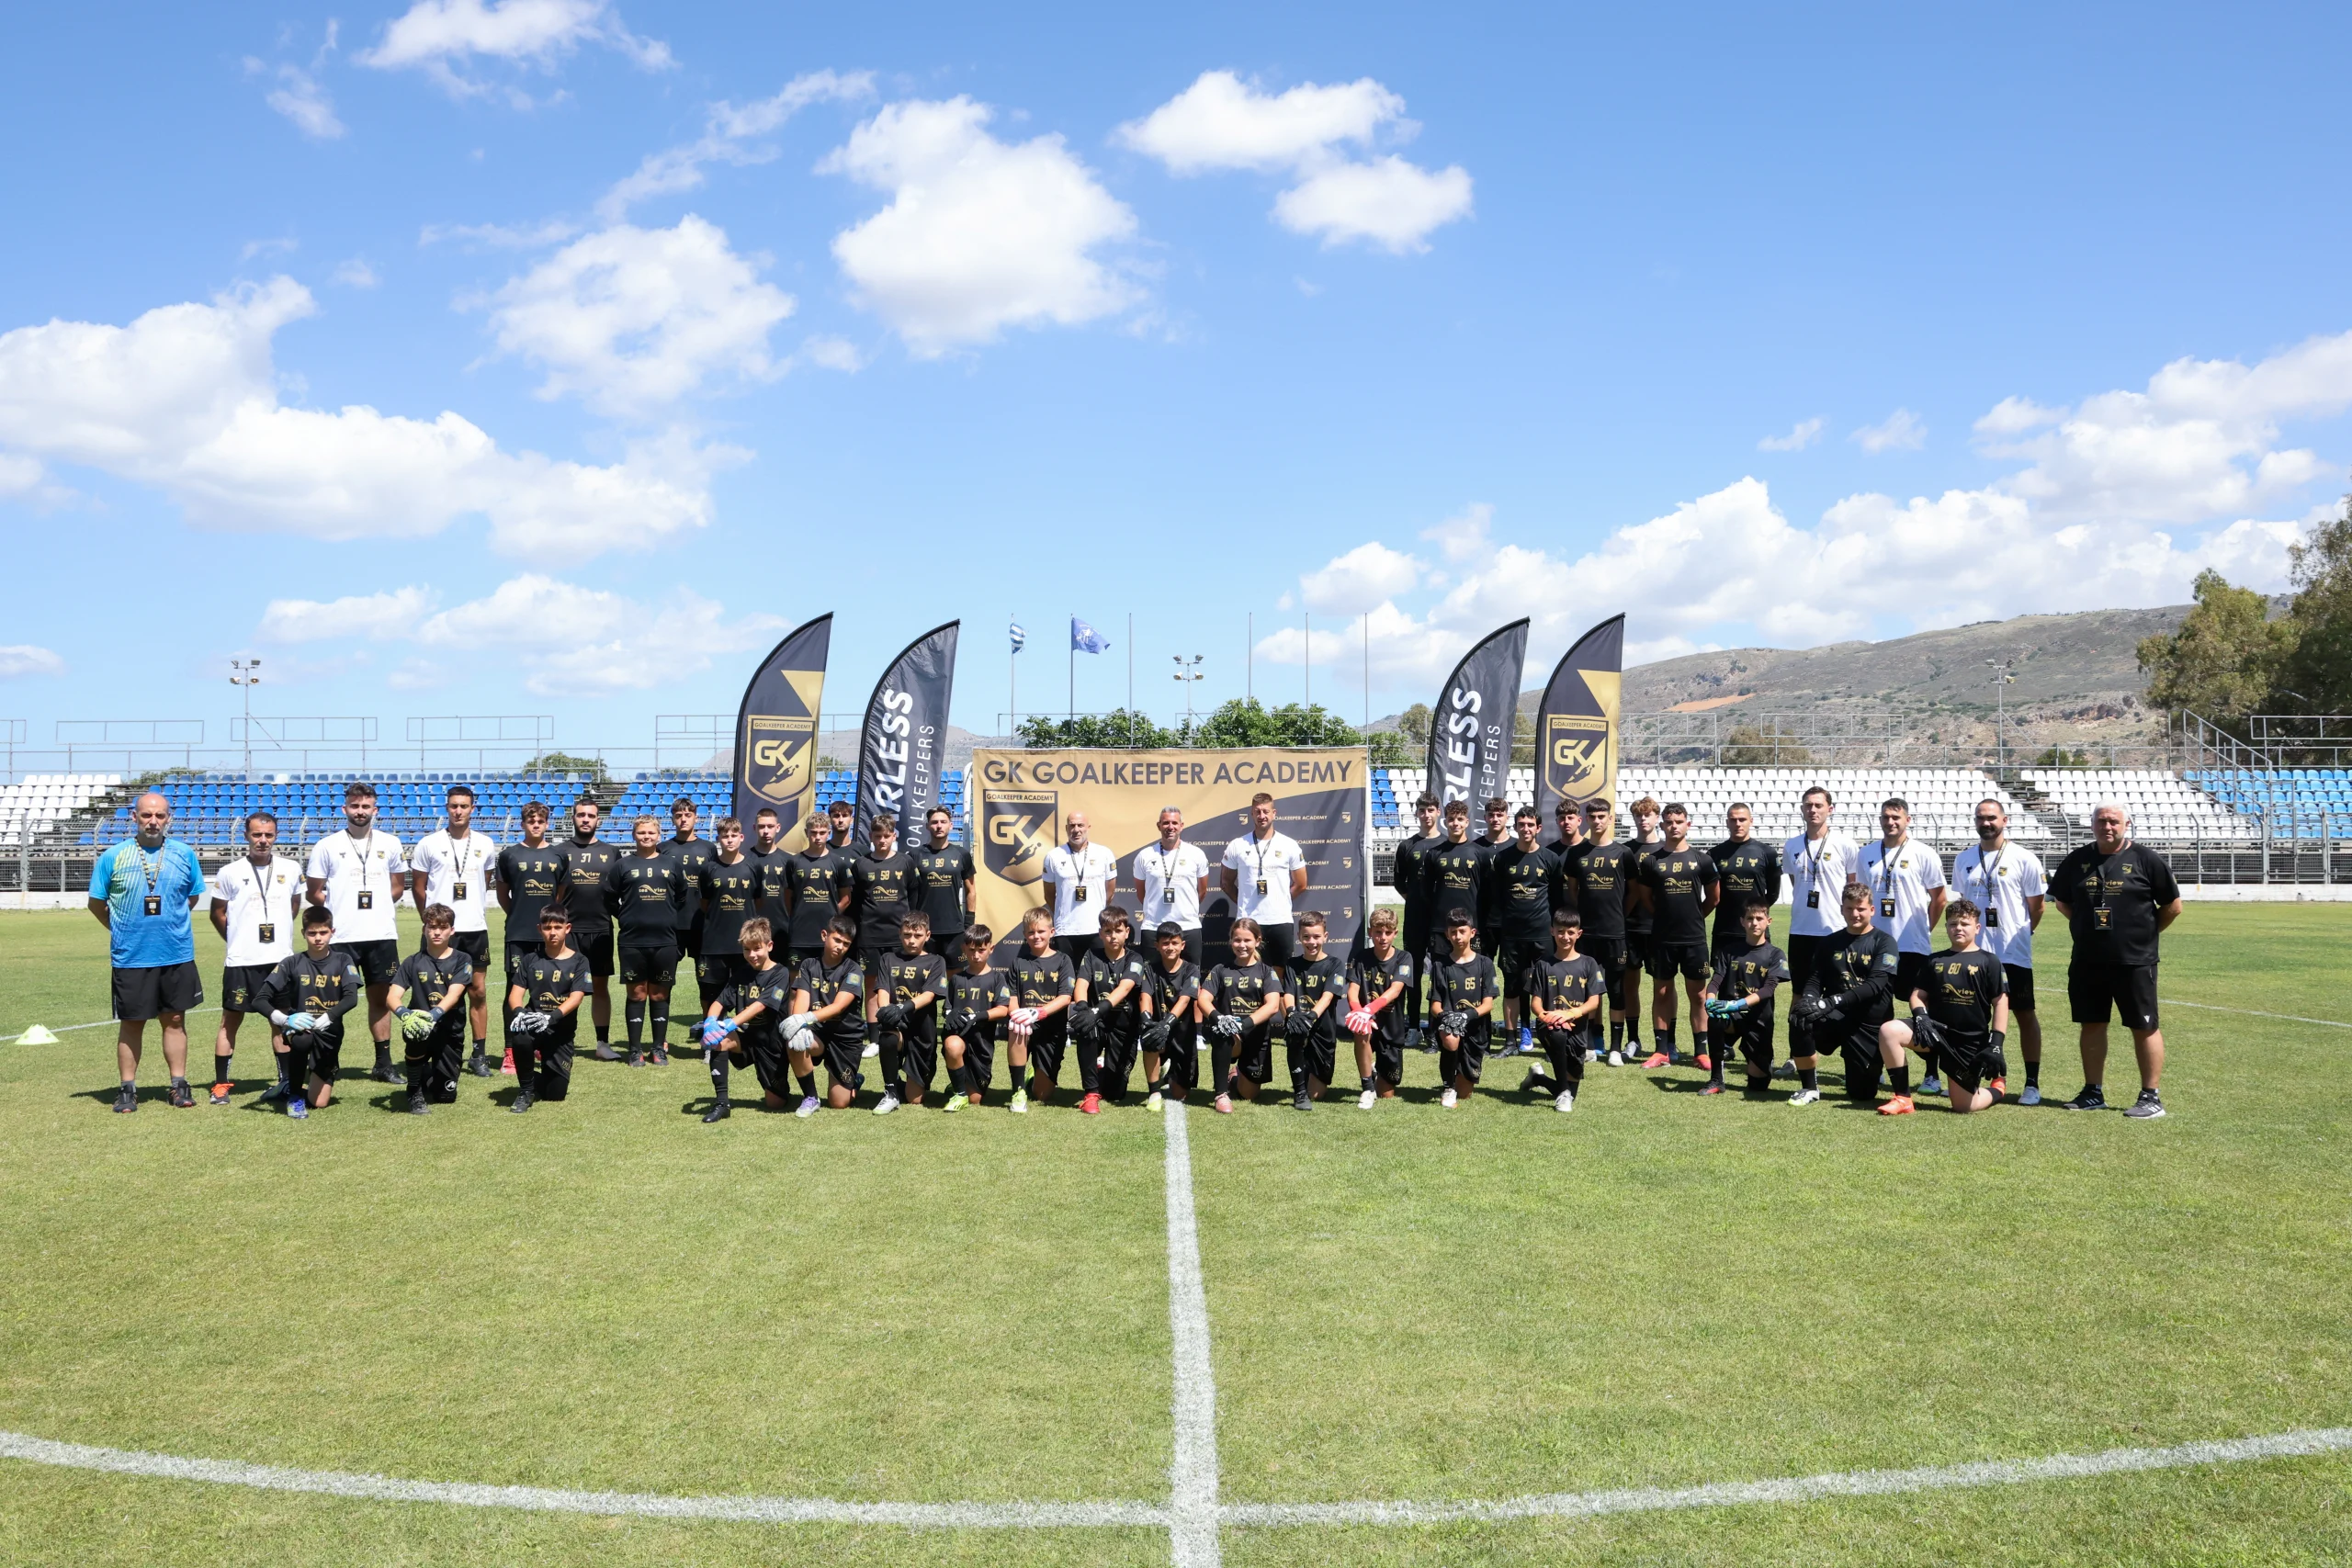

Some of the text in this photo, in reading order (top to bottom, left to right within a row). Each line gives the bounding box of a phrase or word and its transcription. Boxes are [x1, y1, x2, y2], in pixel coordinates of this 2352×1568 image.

[754, 739, 794, 768] GK
[1442, 688, 1482, 827] RLESS
[1554, 739, 1591, 767] GK
[871, 689, 913, 852] RLESS
[984, 760, 1352, 785] GK GOALKEEPER ACADEMY
[1474, 725, 1501, 838] ALKEEPERS
[906, 725, 934, 851] OALKEEPERS
[986, 793, 1054, 802] GOALKEEPER ACADEMY
[989, 814, 1034, 847] GK
[581, 852, 591, 863] 37
[683, 855, 689, 865] 5
[934, 857, 944, 868] 99
[1593, 857, 1604, 868] 87
[1736, 857, 1744, 867] 51
[534, 861, 542, 873] 31
[647, 867, 653, 878] 8
[809, 867, 820, 879] 25
[1522, 864, 1530, 875] 9
[1671, 862, 1683, 873] 88
[880, 870, 890, 881] 58
[904, 966, 917, 979] 55
[1948, 963, 1962, 975] 80
[315, 974, 327, 988] 69
[1034, 970, 1045, 983] 44
[1238, 976, 1250, 989] 22
[1306, 975, 1318, 987] 30
[1564, 975, 1573, 987] 18
[1464, 976, 1476, 990] 65
[970, 987, 980, 999] 77
[323, 998, 339, 1007] view
